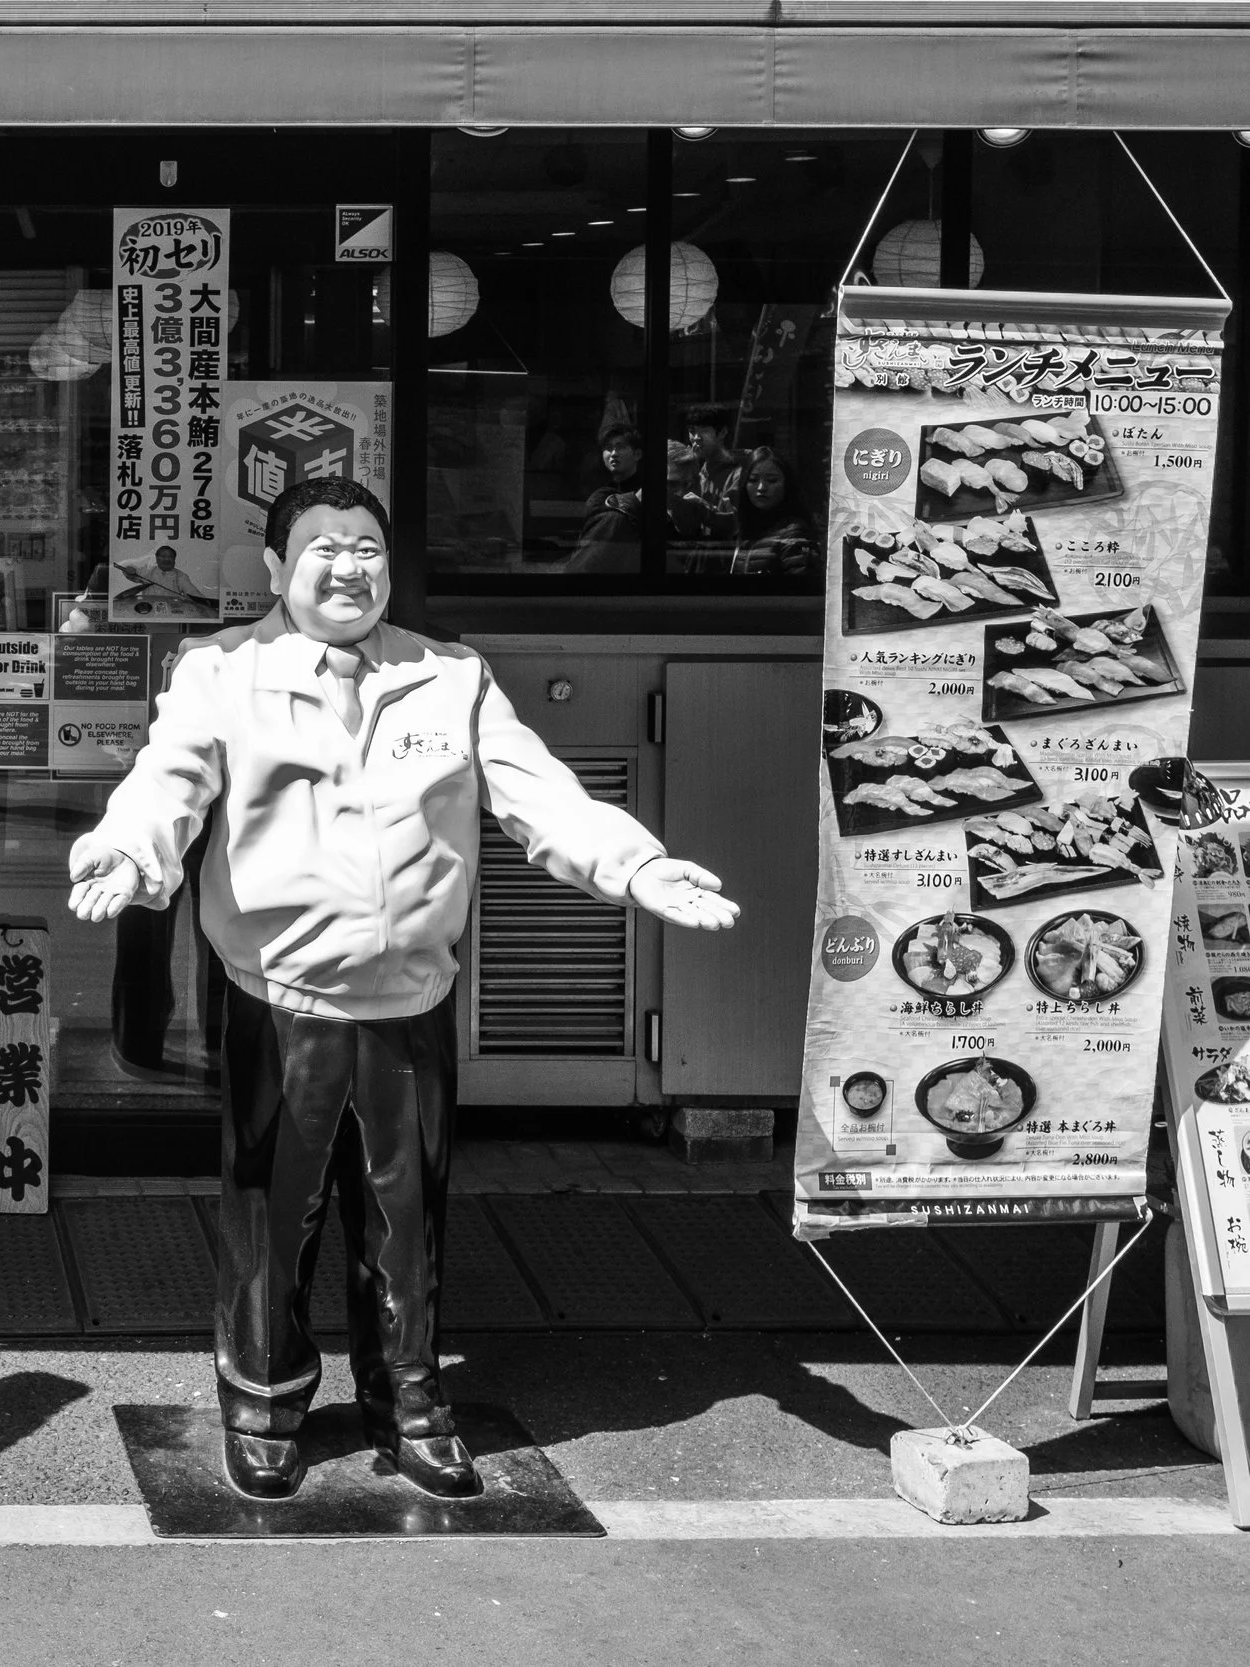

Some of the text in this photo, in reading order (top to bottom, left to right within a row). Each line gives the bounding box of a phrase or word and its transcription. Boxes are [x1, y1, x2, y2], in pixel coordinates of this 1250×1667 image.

[140, 220, 203, 237] 2019年
[120, 233, 221, 276] 初セリ
[339, 248, 389, 259] ALSOK
[122, 286, 142, 426] 史上最高値更新!!
[944, 343, 1217, 392] ランチメニュー
[1032, 393, 1086, 410] ランチ時間
[148, 282, 184, 541] 3億3,360万円
[372, 394, 388, 481] 築地場外市場
[1122, 426, 1164, 440] ぼたん
[852, 448, 903, 469] にぎり
[1154, 454, 1202, 470] 1,500円
[863, 470, 889, 481] nigiri
[116, 433, 144, 541] 落札の店
[859, 650, 976, 667] 人気ランキングにぎり
[11, 660, 46, 674] Drink
[928, 682, 975, 697] 2,000円
[118, 723, 141, 731] FROM
[1042, 737, 1138, 751] まぐろざんまい
[864, 848, 958, 862] 特選すしざんまい
[1173, 913, 1196, 953] 焼物
[825, 936, 875, 954] どんぶり
[832, 955, 863, 965] donburi
[900, 1000, 984, 1016] 海鮮ちらし丼
[1036, 1000, 1121, 1015] 特上ちらし丼
[1185, 986, 1209, 1026] 前菜
[1083, 1038, 1131, 1053] 2,000円
[1191, 1045, 1233, 1064] サラダ
[1072, 1153, 1118, 1166] 2,800円
[1208, 1128, 1236, 1189] 蒸し物
[824, 1173, 867, 1186] 料金税別
[910, 1203, 1030, 1215] SUSHIZANMAI
[1227, 1216, 1248, 1254] お椀
